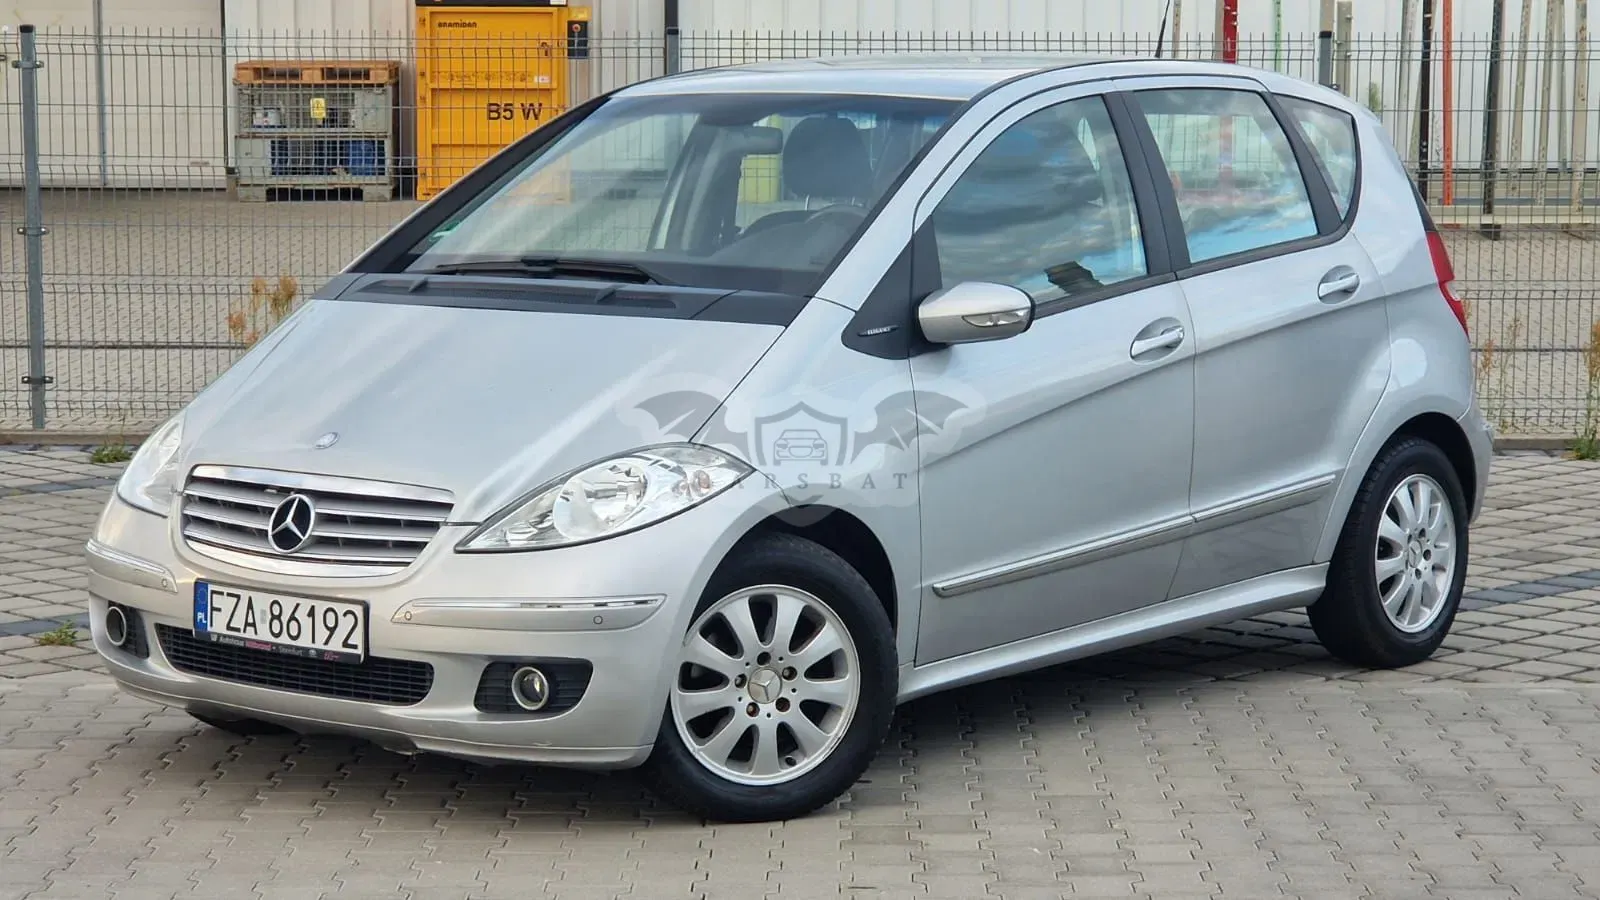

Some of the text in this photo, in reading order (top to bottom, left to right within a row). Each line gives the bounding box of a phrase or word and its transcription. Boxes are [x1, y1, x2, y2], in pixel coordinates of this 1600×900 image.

[487, 103, 543, 121] B5 W
[197, 612, 207, 624] PL
[210, 589, 359, 650] FZA 86192
